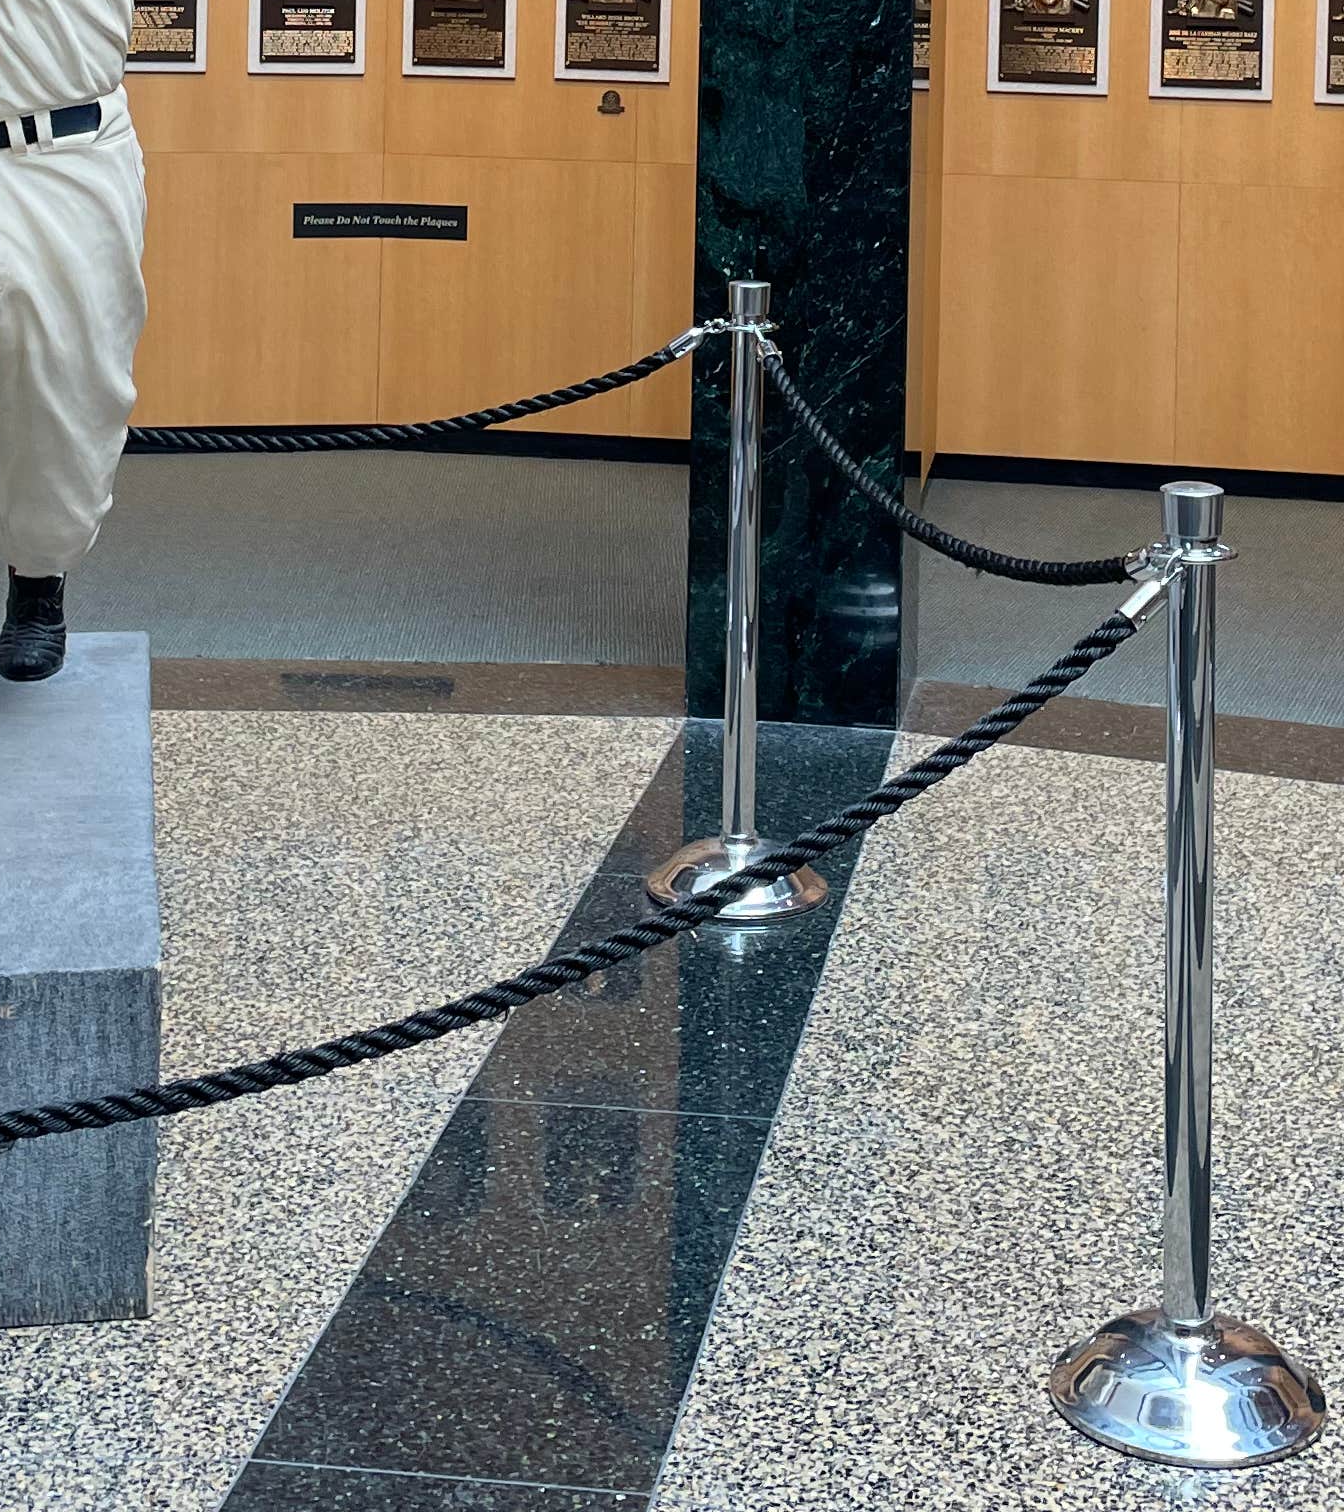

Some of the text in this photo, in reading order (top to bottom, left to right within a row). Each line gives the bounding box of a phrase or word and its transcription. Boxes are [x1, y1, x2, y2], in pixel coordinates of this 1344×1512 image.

[303, 215, 458, 228] Please Do Not Touch the Plaques
